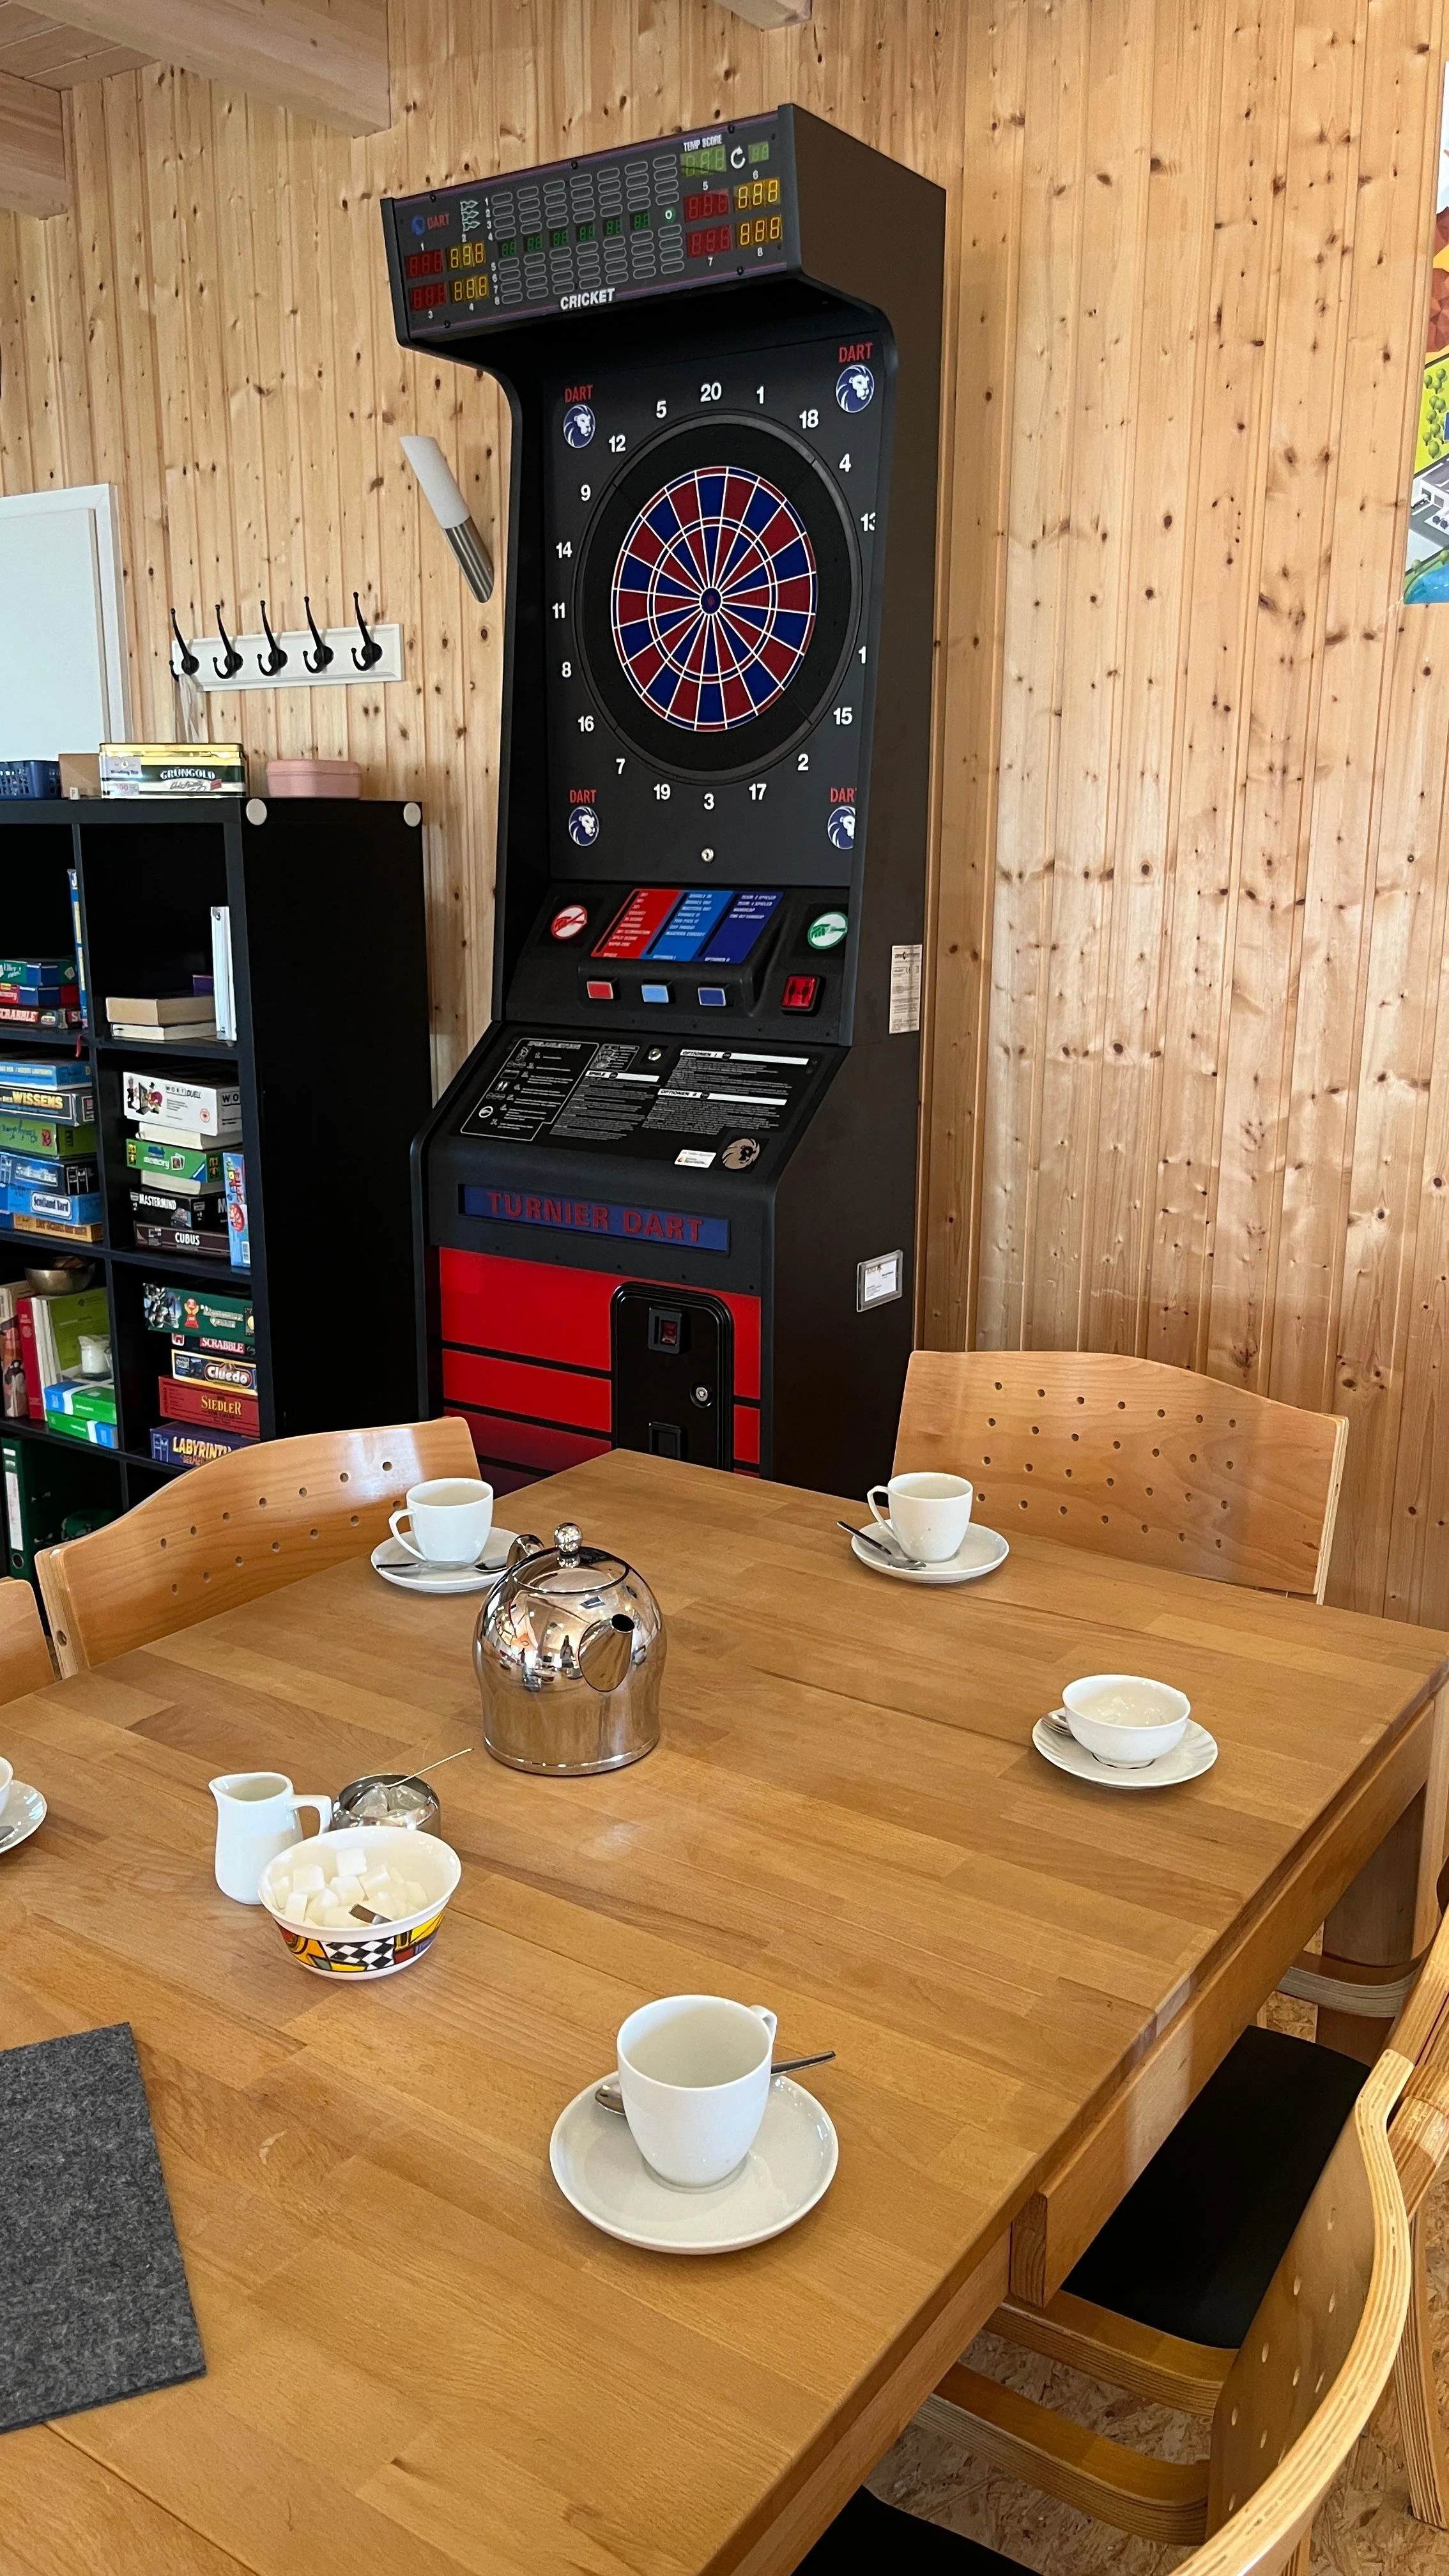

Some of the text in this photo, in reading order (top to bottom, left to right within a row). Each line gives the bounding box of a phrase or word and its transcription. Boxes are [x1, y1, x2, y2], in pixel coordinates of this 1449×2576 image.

[683, 134, 723, 152] TEMP SCORE
[753, 170, 758, 180] 6
[703, 181, 709, 190] 5
[484, 196, 489, 206] 1
[427, 213, 449, 230] DART
[485, 209, 491, 218] 2
[486, 220, 492, 229] 3
[461, 234, 467, 243] 2
[487, 232, 493, 241] 4
[420, 242, 425, 251] 1
[757, 247, 763, 257] 8
[491, 262, 496, 272] 5
[708, 257, 714, 266] 7
[492, 273, 498, 282] 6
[560, 288, 615, 310] CRICKET
[427, 310, 433, 319] 3
[838, 342, 873, 363] DART
[565, 385, 594, 404] DART
[700, 383, 722, 402] 20
[756, 386, 765, 404] 1
[656, 401, 666, 418] 5
[799, 410, 819, 429] 18
[608, 434, 626, 453] 12
[839, 454, 851, 472] 4
[580, 485, 591, 502] 9
[556, 541, 572, 558] 14
[552, 604, 565, 619] 11
[859, 646, 867, 664] 1
[562, 661, 571, 677] 8
[578, 716, 594, 732] 16
[833, 707, 852, 725] 15
[616, 758, 625, 774] 7
[797, 753, 809, 771] 2
[569, 789, 597, 804] DART
[653, 783, 671, 801] 19
[749, 783, 767, 801] 17
[830, 787, 857, 803] DAR
[704, 793, 714, 810] 3
[0, 1008, 36, 1022] CRABBLE
[12, 1091, 63, 1110] WISSENS
[34, 1196, 68, 1212] Scotland Yard
[139, 1193, 177, 1210] MASTERMIND
[487, 1192, 704, 1244] TURNIER DART
[175, 1232, 200, 1245] CUBUS
[202, 1337, 243, 1353] SCRABBLE
[208, 1366, 248, 1384] Cluedo
[201, 1395, 241, 1416] SIEDLER
